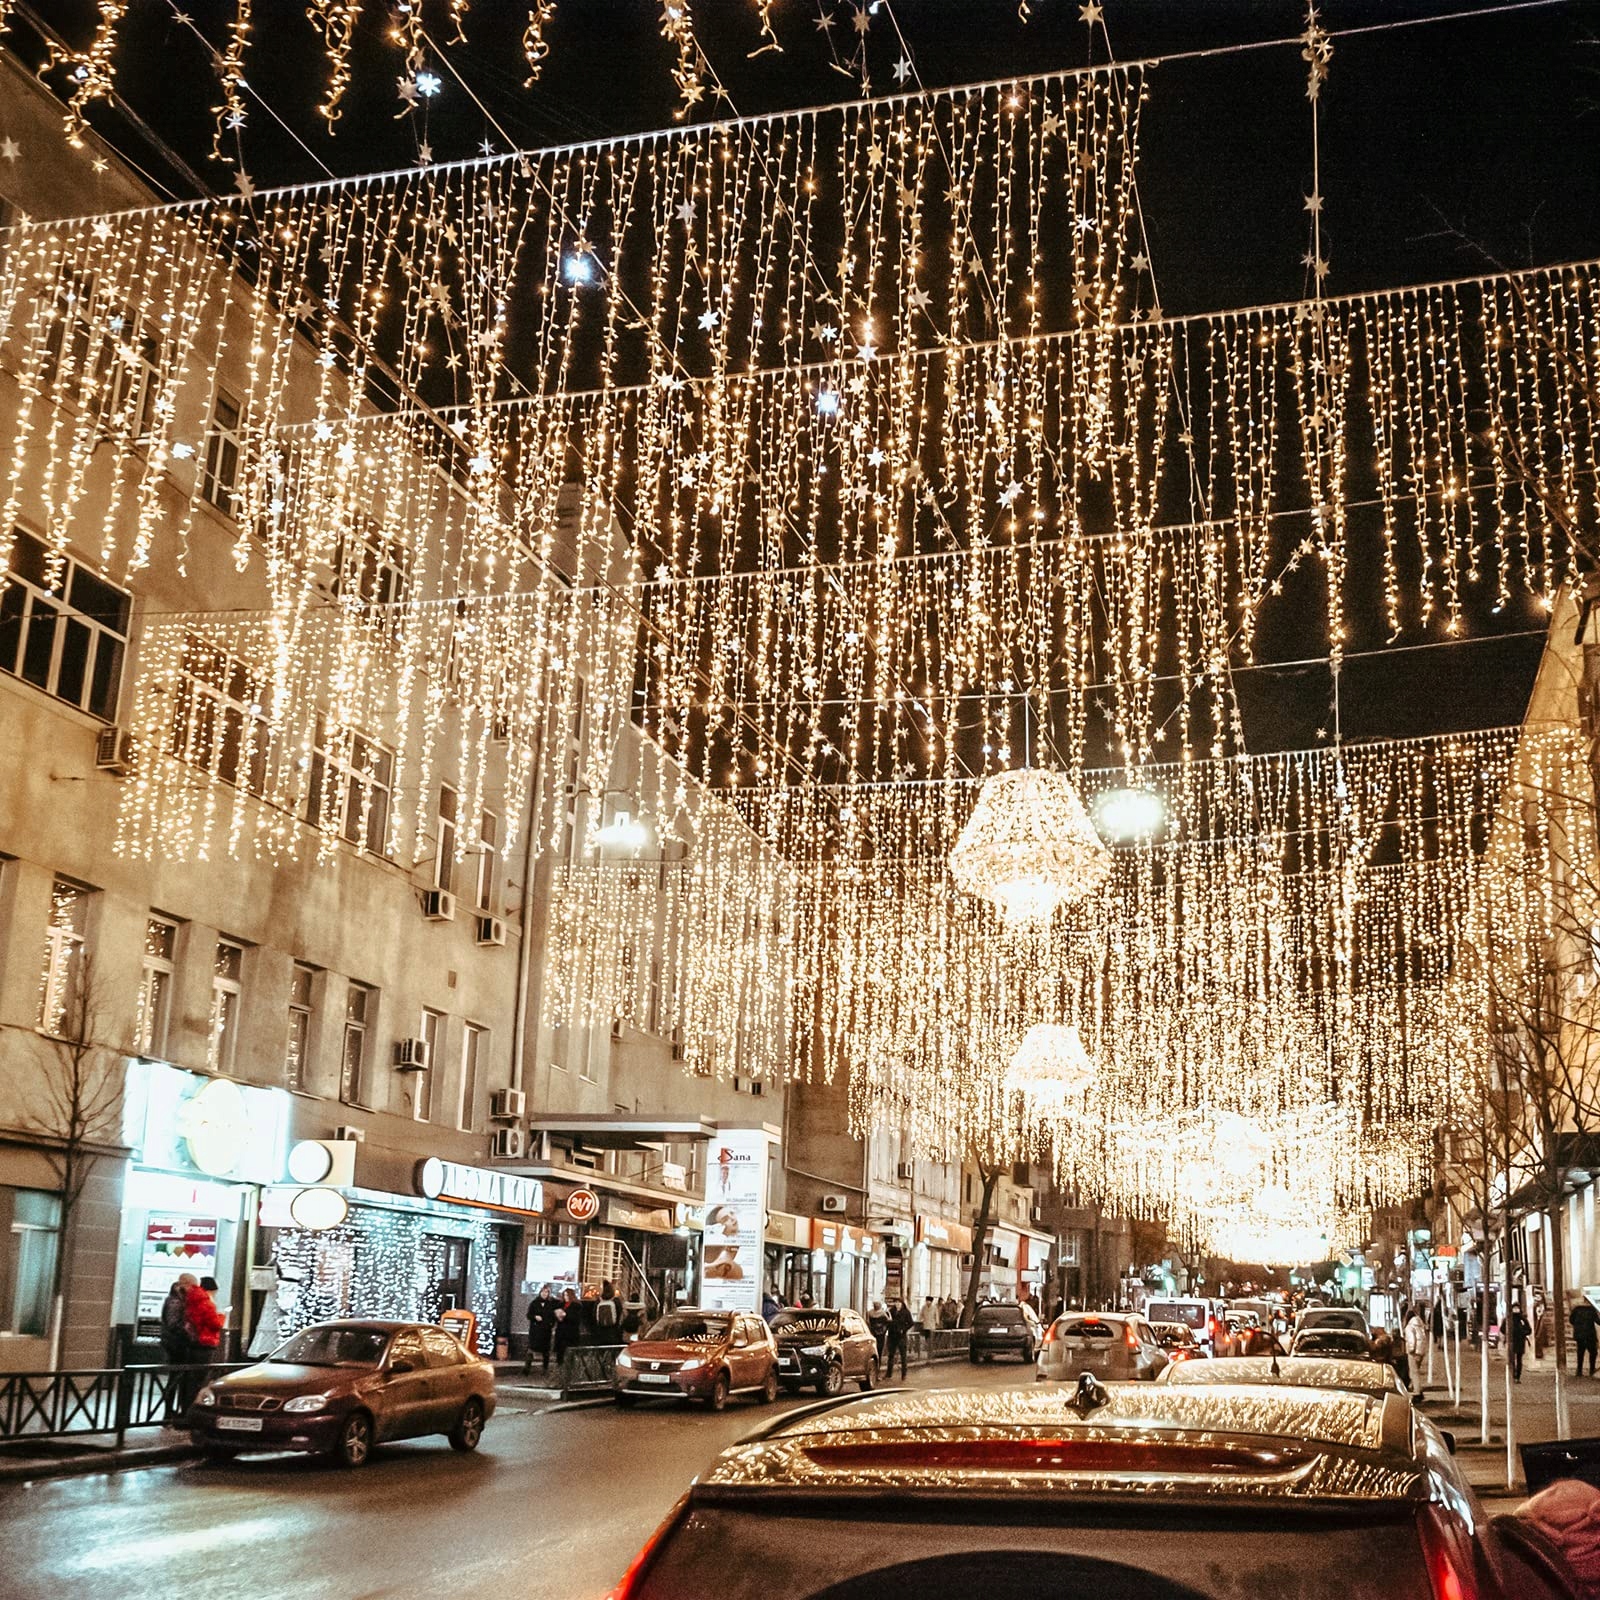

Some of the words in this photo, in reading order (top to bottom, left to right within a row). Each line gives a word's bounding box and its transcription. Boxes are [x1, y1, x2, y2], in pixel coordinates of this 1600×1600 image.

[717, 1148, 751, 1162] Sana
[501, 1177, 543, 1212] KAVA
[570, 1197, 594, 1213] 24/7
